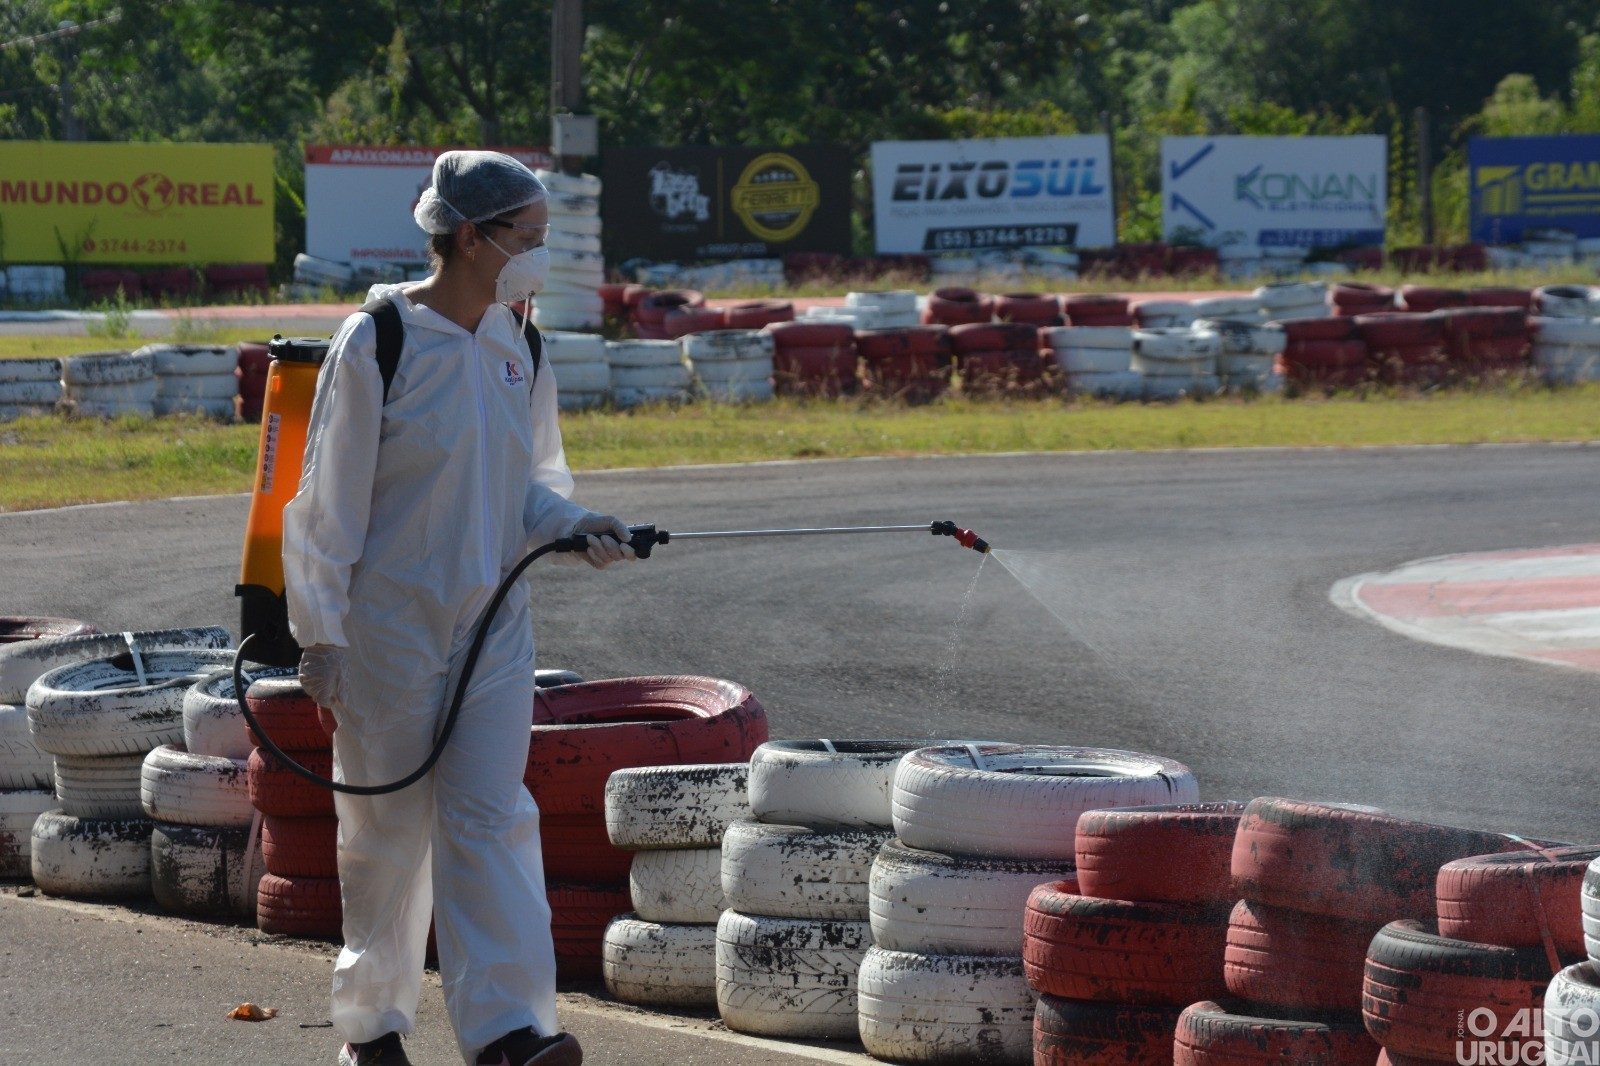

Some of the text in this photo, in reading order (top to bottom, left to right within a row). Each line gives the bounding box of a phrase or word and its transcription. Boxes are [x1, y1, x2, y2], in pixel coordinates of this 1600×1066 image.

[0, 180, 264, 206] MUNDO REAL
[891, 158, 1105, 201] EIXOSUL
[1235, 166, 1377, 205] KONAN
